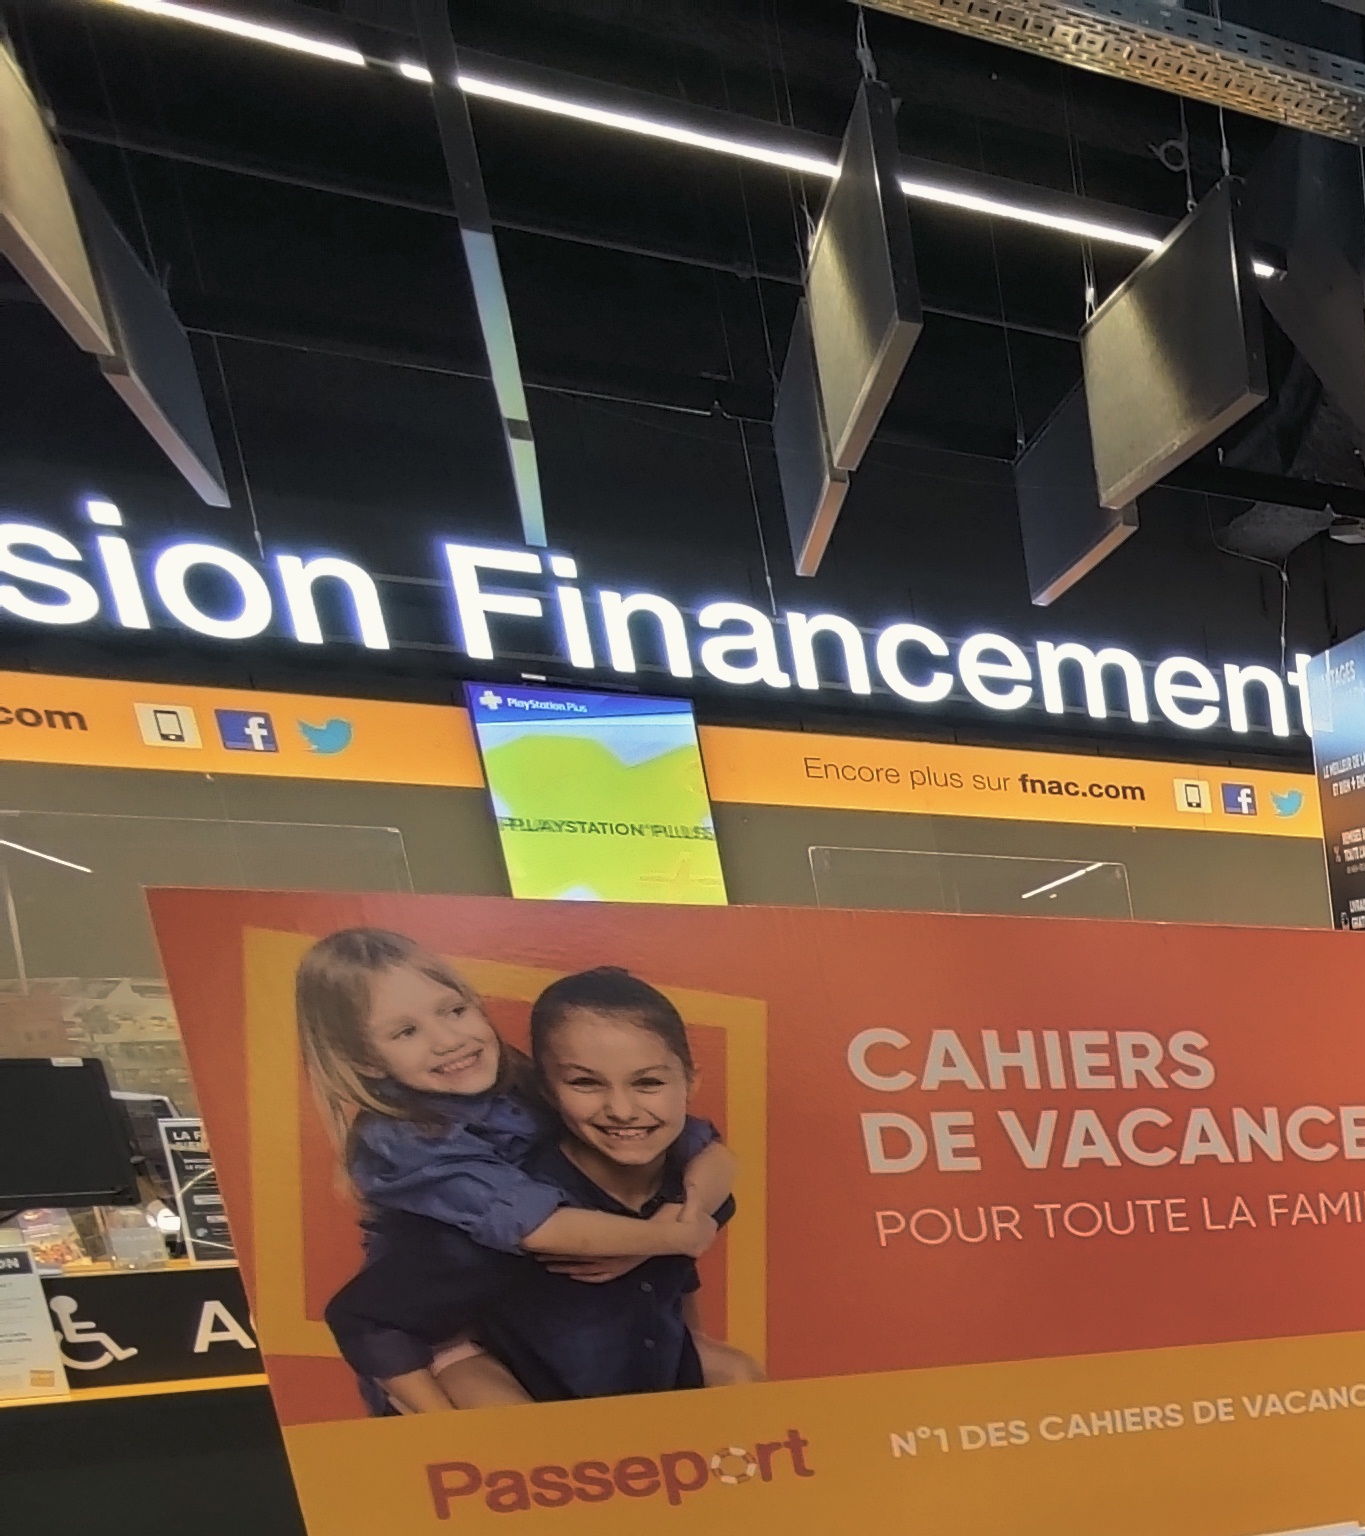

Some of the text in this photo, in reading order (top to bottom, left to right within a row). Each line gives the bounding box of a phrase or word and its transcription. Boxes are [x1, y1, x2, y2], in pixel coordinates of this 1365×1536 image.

[0, 499, 1319, 739] sion Financement
[802, 756, 1146, 802] Encore plus sur fnac.com
[846, 1027, 1216, 1092] CAHIERS
[859, 1110, 982, 1174] DE
[875, 1204, 1023, 1248] POUR
[1034, 1198, 1190, 1239] TOUTE
[1202, 1195, 1257, 1231] LA
[194, 1300, 257, 1353] A
[889, 1427, 950, 1459] N°1
[959, 1420, 1030, 1450] DES
[1038, 1403, 1184, 1441] CAHIERS
[1192, 1400, 1235, 1426] DE
[426, 1429, 815, 1521] Passeport
